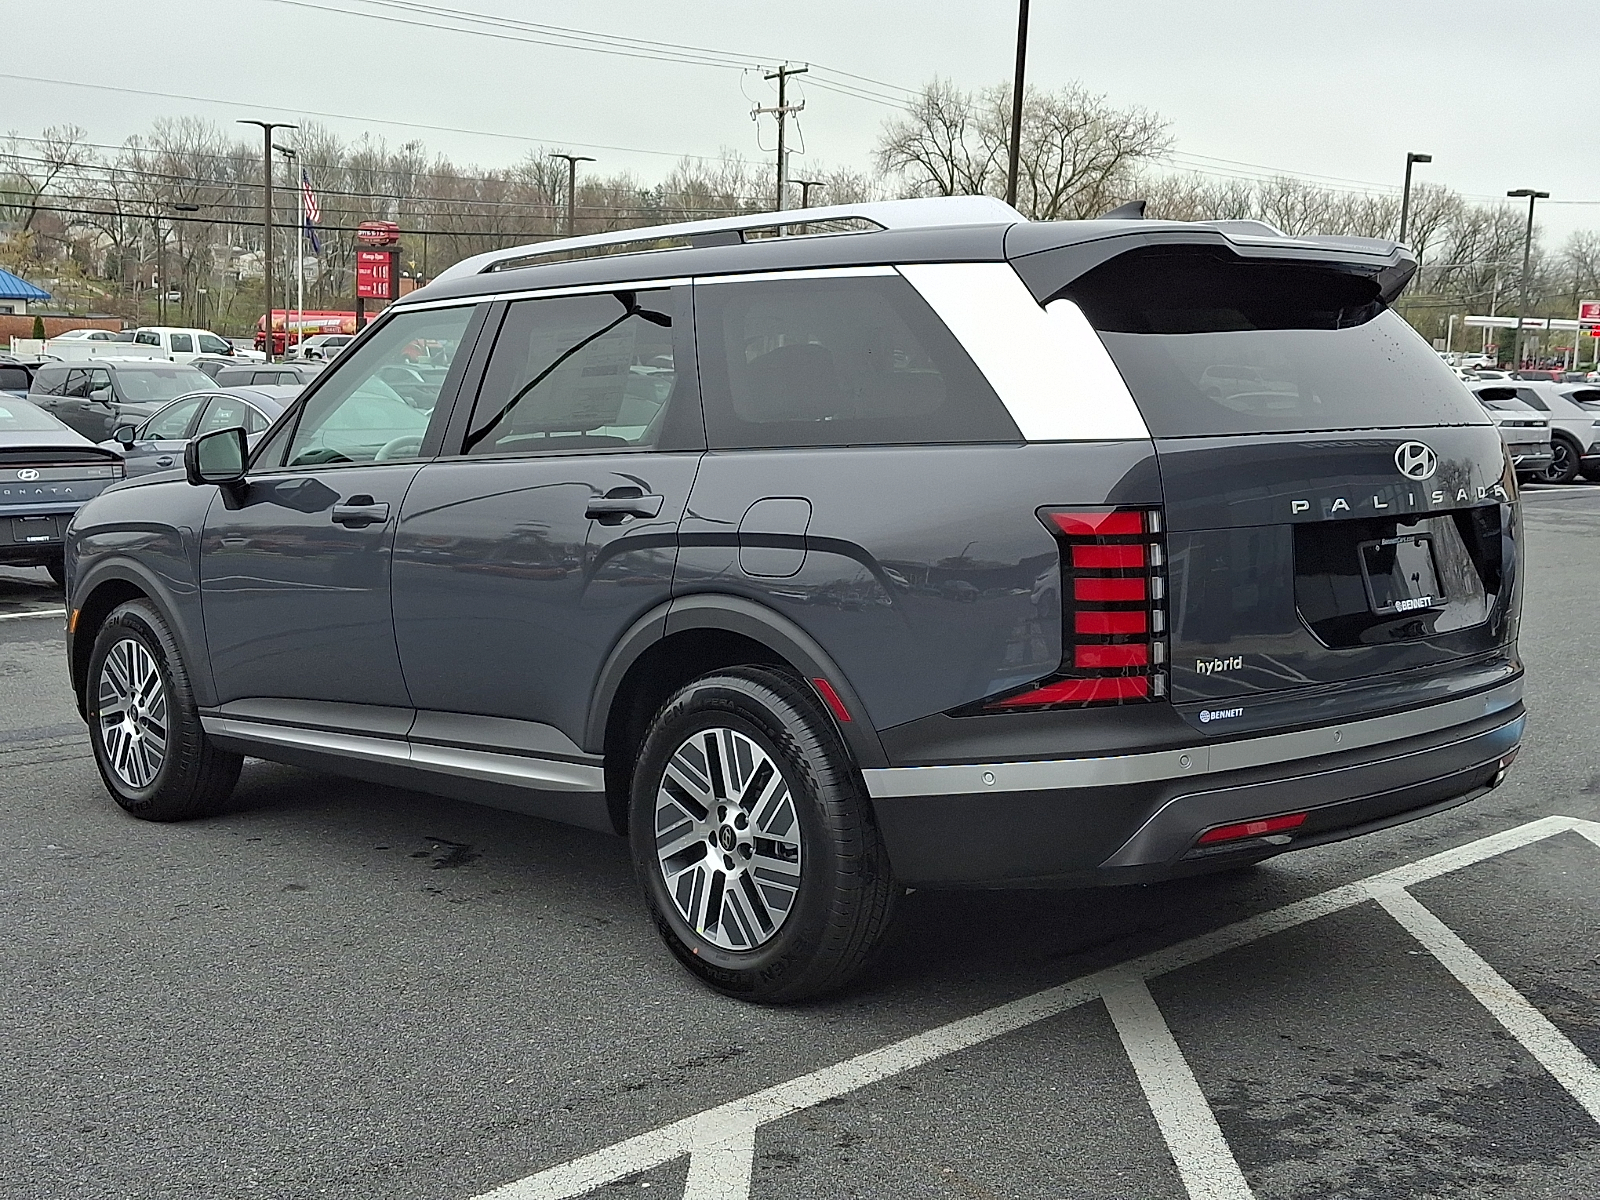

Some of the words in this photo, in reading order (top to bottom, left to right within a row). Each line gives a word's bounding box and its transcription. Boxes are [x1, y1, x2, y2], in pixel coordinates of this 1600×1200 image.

[3, 487, 73, 495] ONATA
[1291, 484, 1504, 515] PALISADE
[1402, 596, 1432, 610] BENNETT
[1196, 655, 1243, 676] hybrid
[1210, 707, 1244, 720] BENNETT
